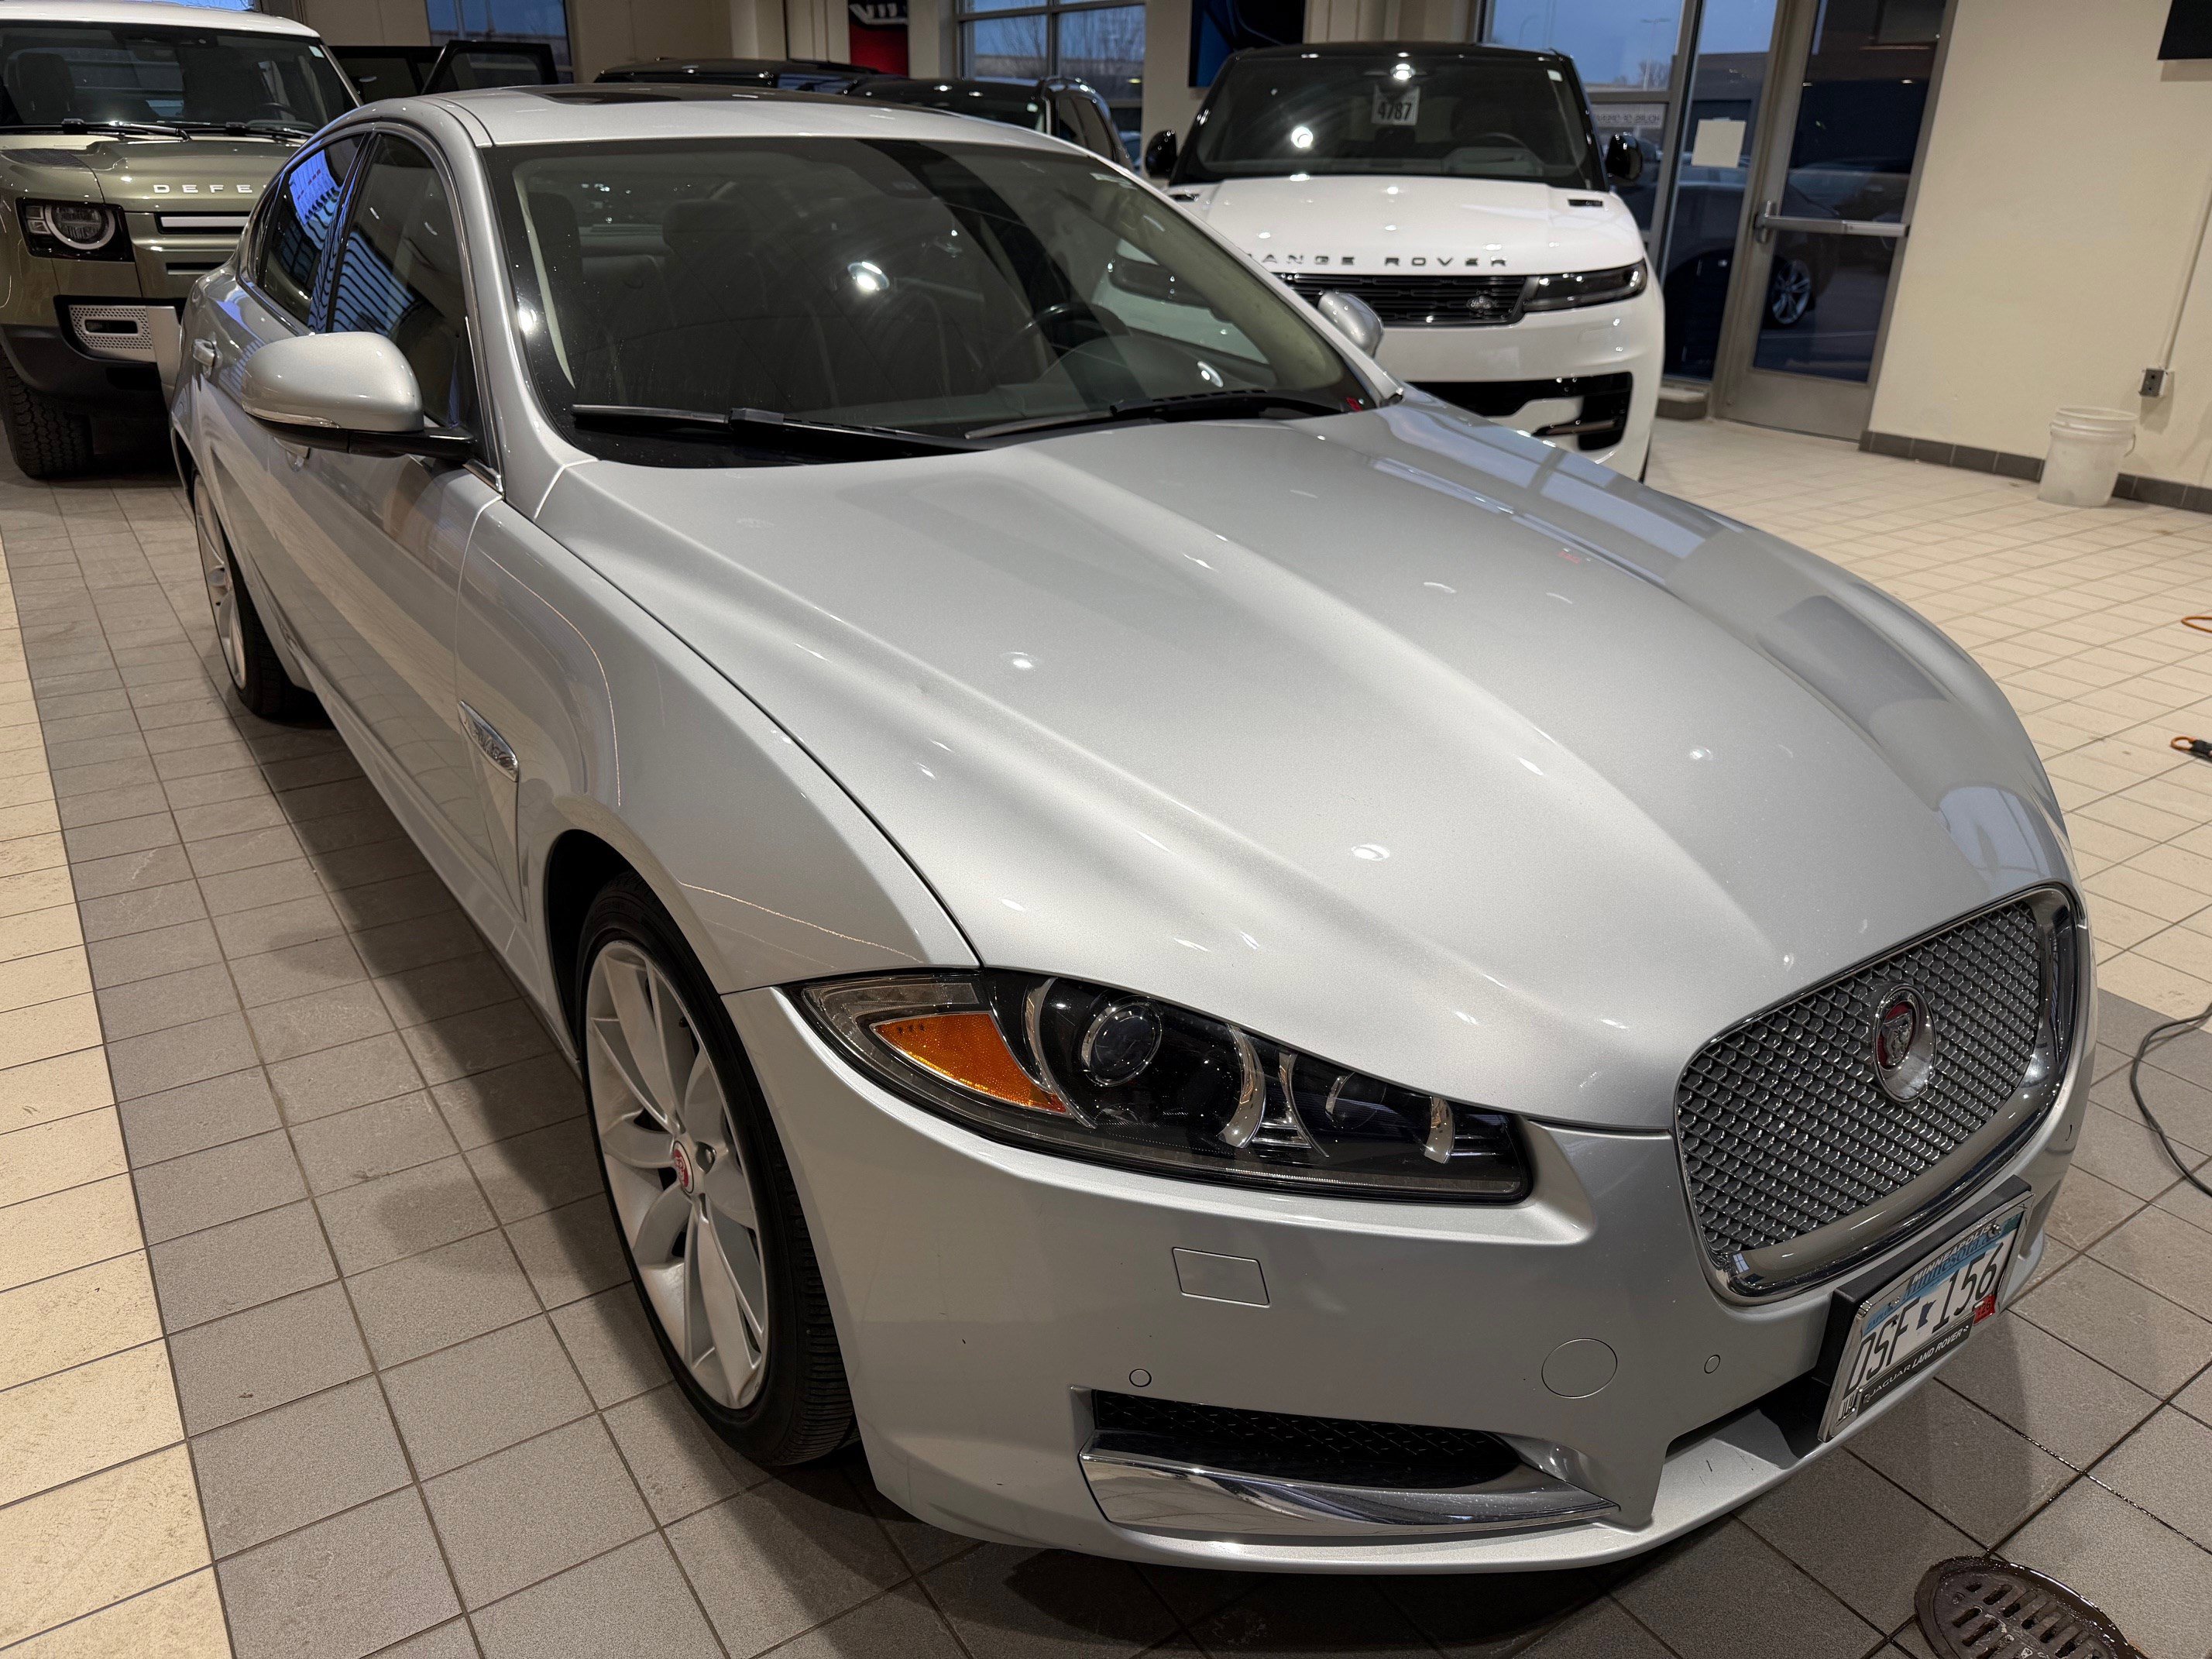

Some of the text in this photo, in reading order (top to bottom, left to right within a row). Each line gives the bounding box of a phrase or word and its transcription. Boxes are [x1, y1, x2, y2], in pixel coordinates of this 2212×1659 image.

[1377, 101, 1412, 121] 4787
[153, 184, 267, 194] DEFE
[1248, 252, 1507, 266] ANGE ROVER
[1842, 1242, 2004, 1400] DSF 156
[1869, 1328, 1963, 1397] JAGUAR LAND ROVER
